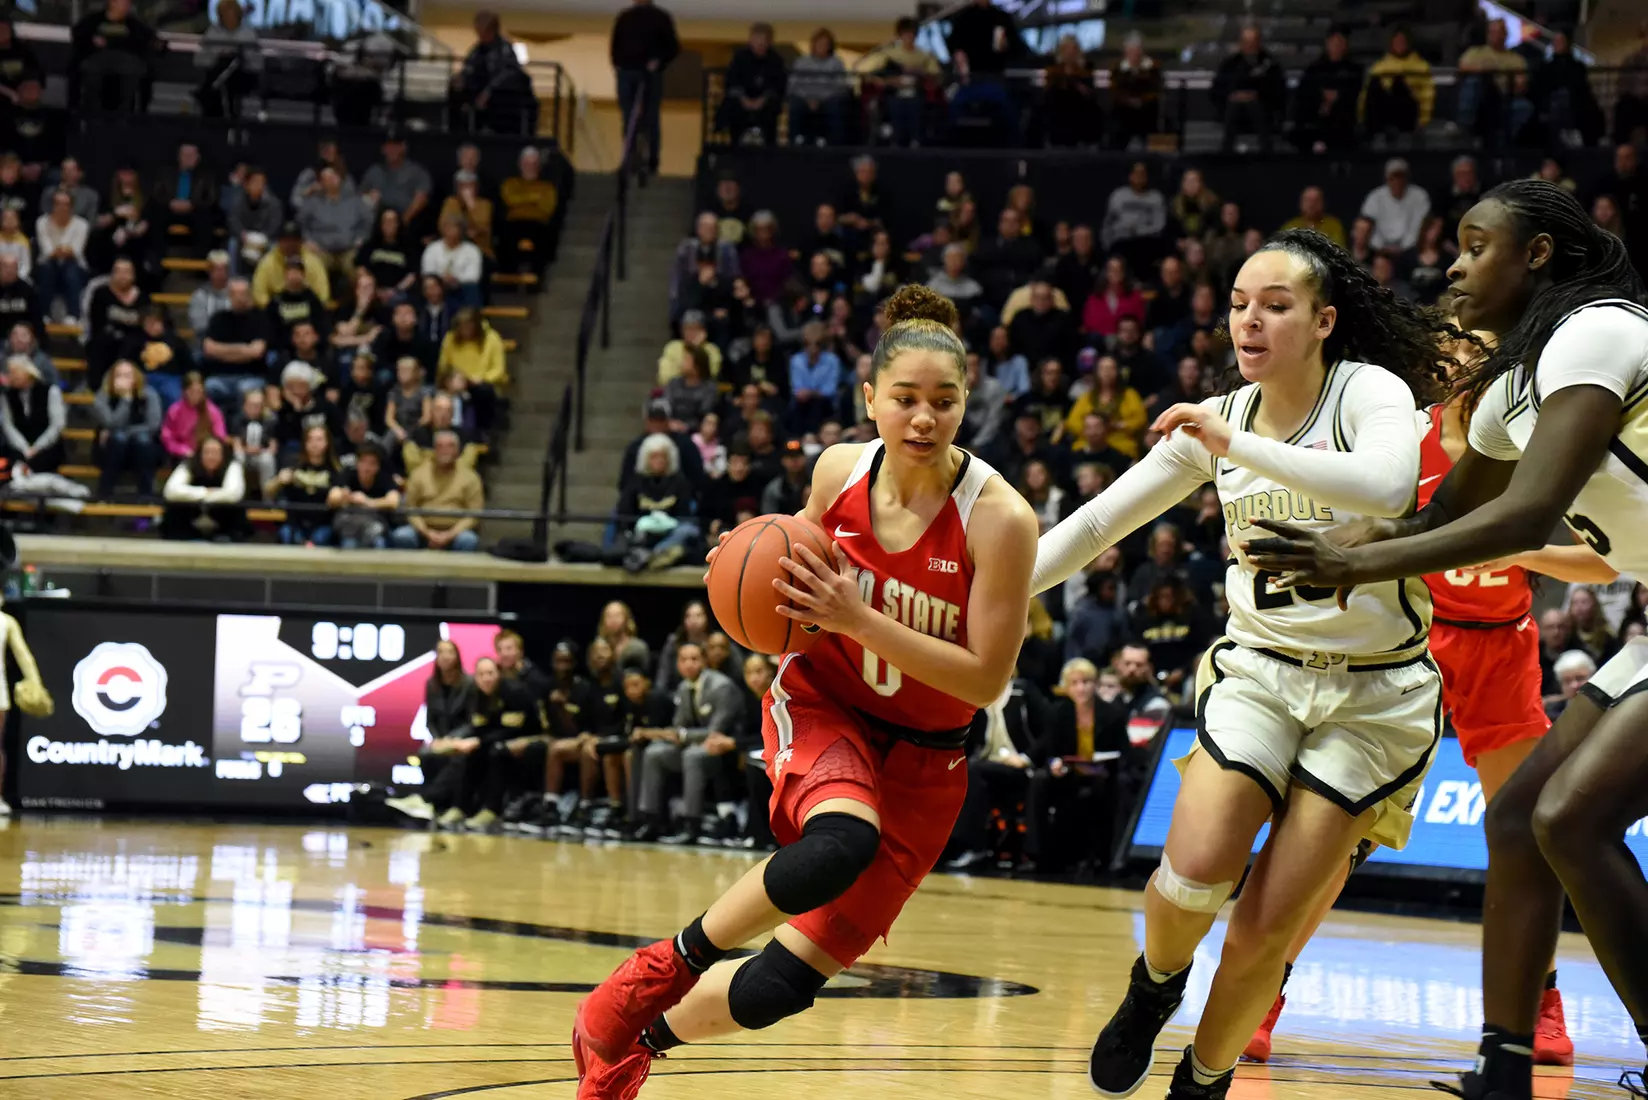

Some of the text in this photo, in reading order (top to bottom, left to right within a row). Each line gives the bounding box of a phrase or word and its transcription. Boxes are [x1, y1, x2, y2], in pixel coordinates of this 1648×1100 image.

[1224, 488, 1333, 537] PURDUE
[882, 576, 960, 640] STATE
[311, 621, 405, 661] 9:00
[240, 696, 302, 743] 26
[27, 735, 205, 770] CountryMark
